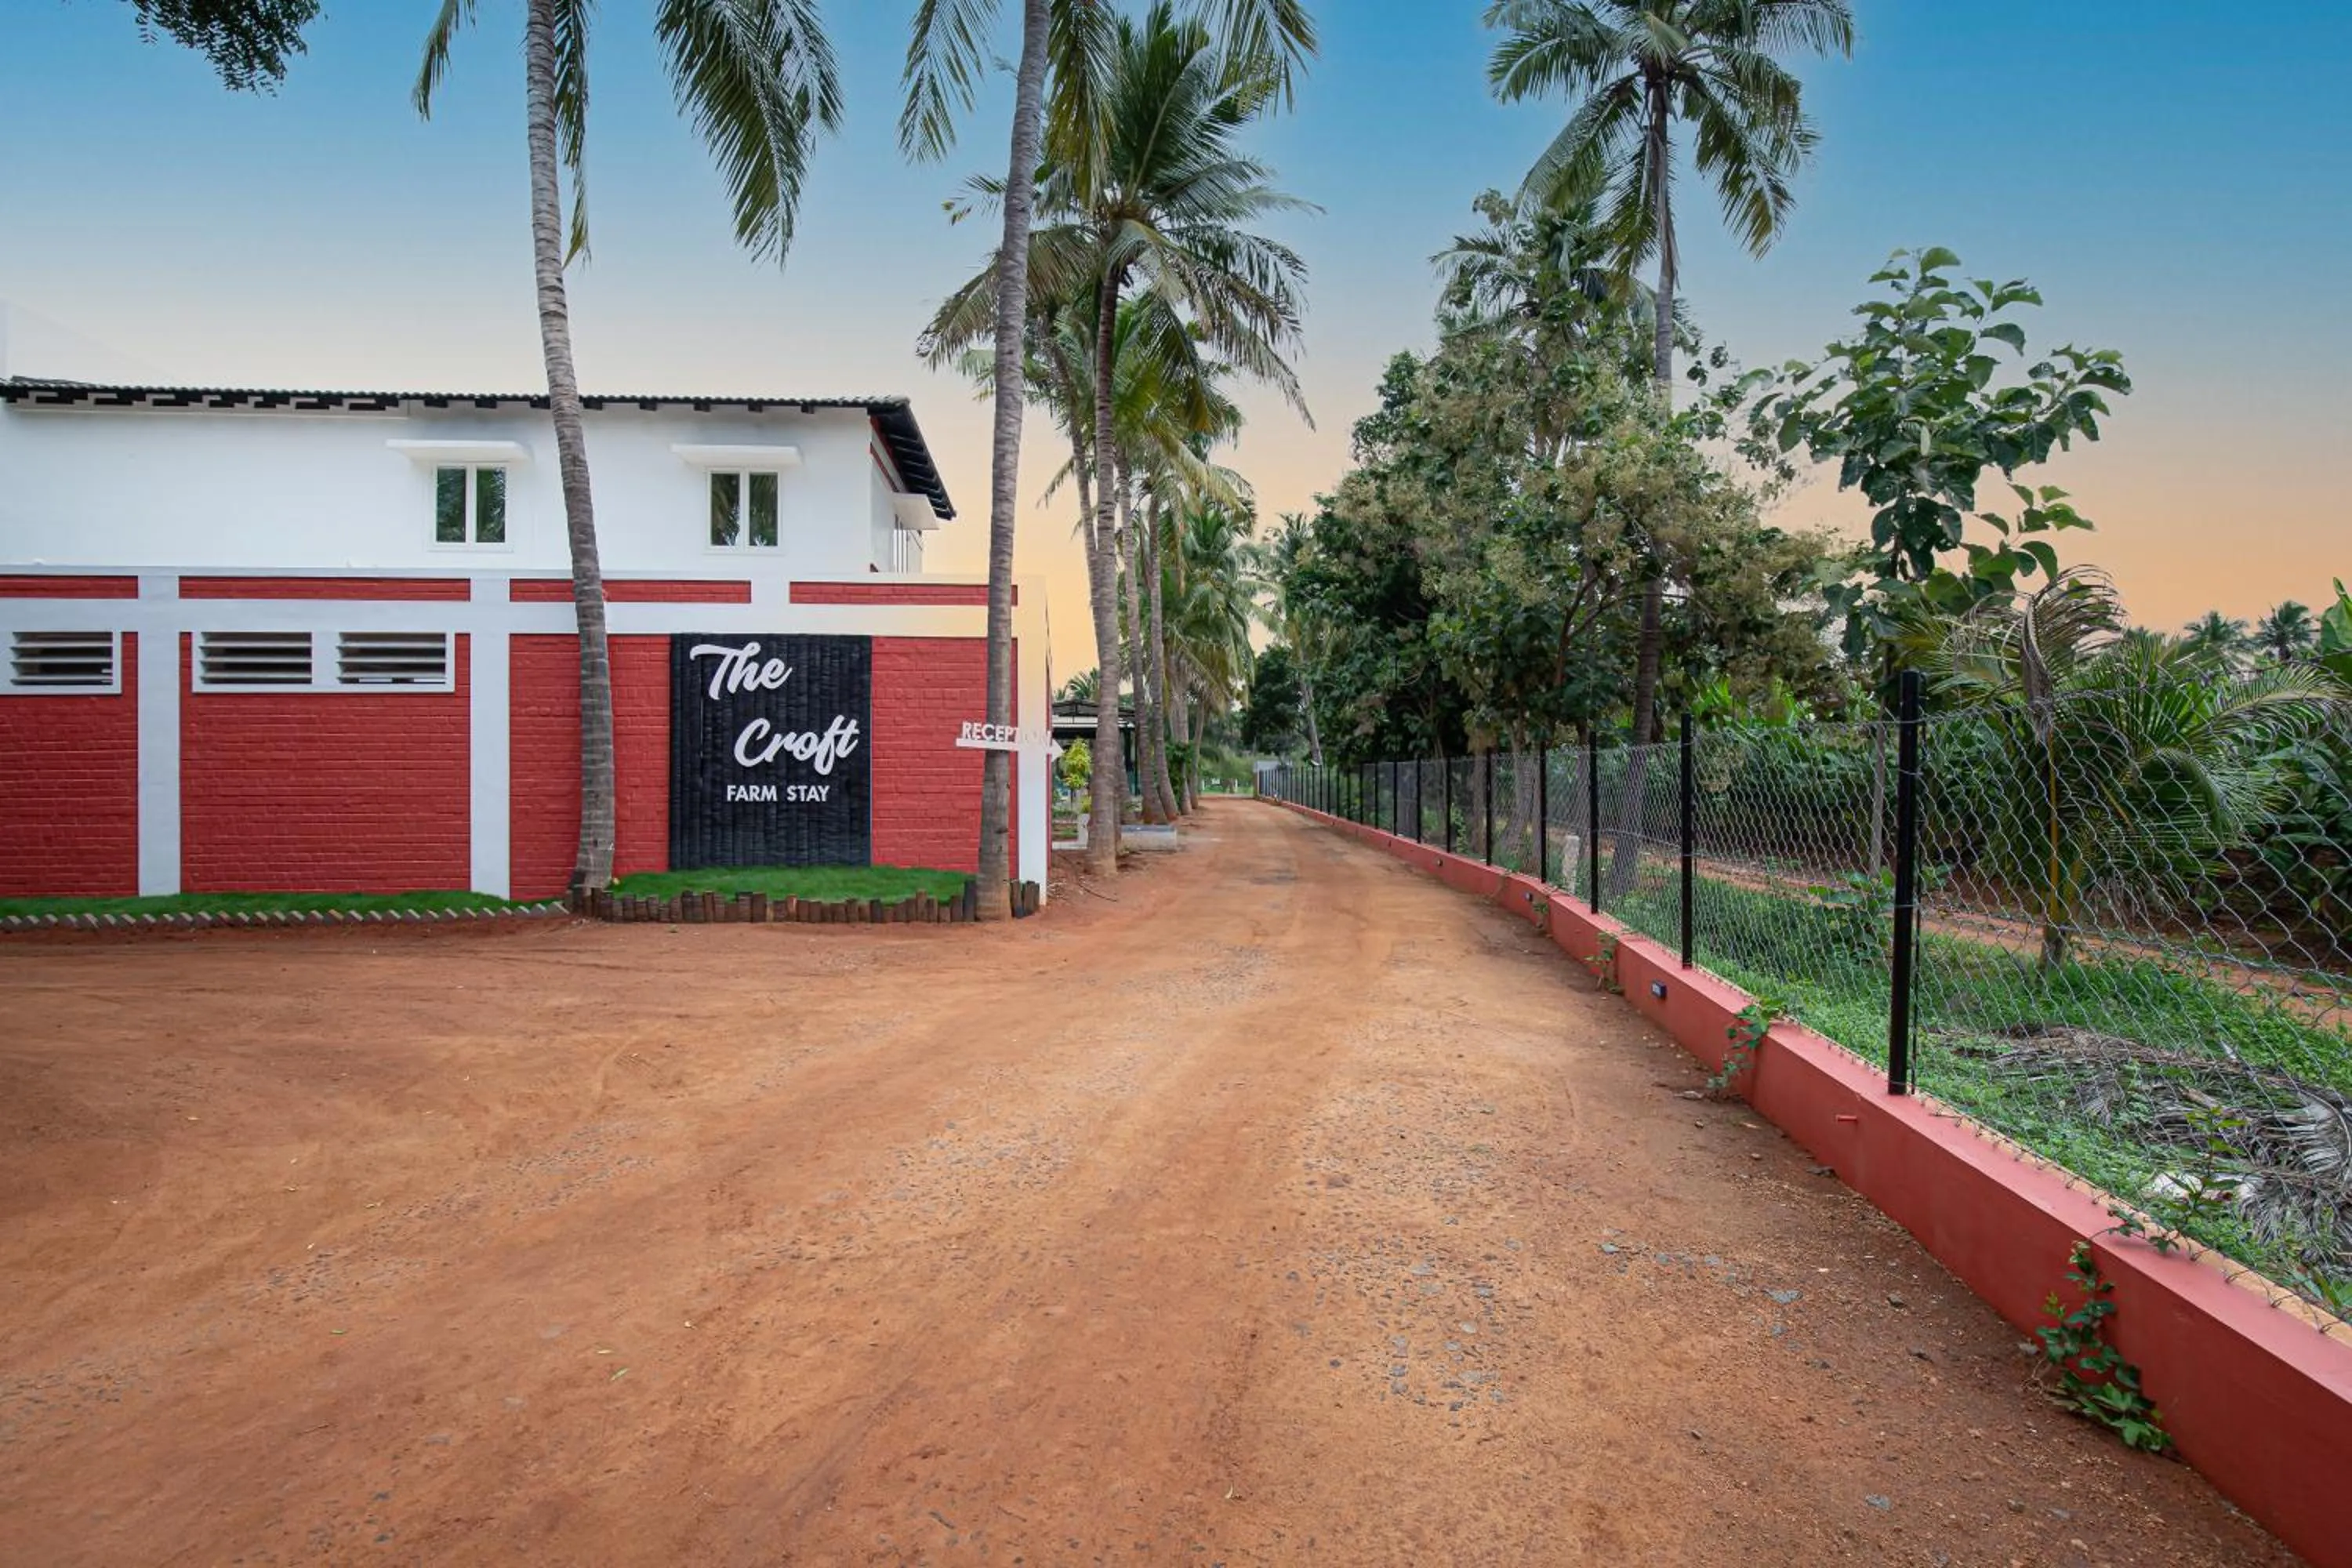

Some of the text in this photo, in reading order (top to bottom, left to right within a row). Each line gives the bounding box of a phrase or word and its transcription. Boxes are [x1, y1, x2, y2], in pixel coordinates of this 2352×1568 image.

[689, 641, 792, 700] The
[734, 714, 860, 775] Croft
[726, 785, 830, 802] FARM STAY
